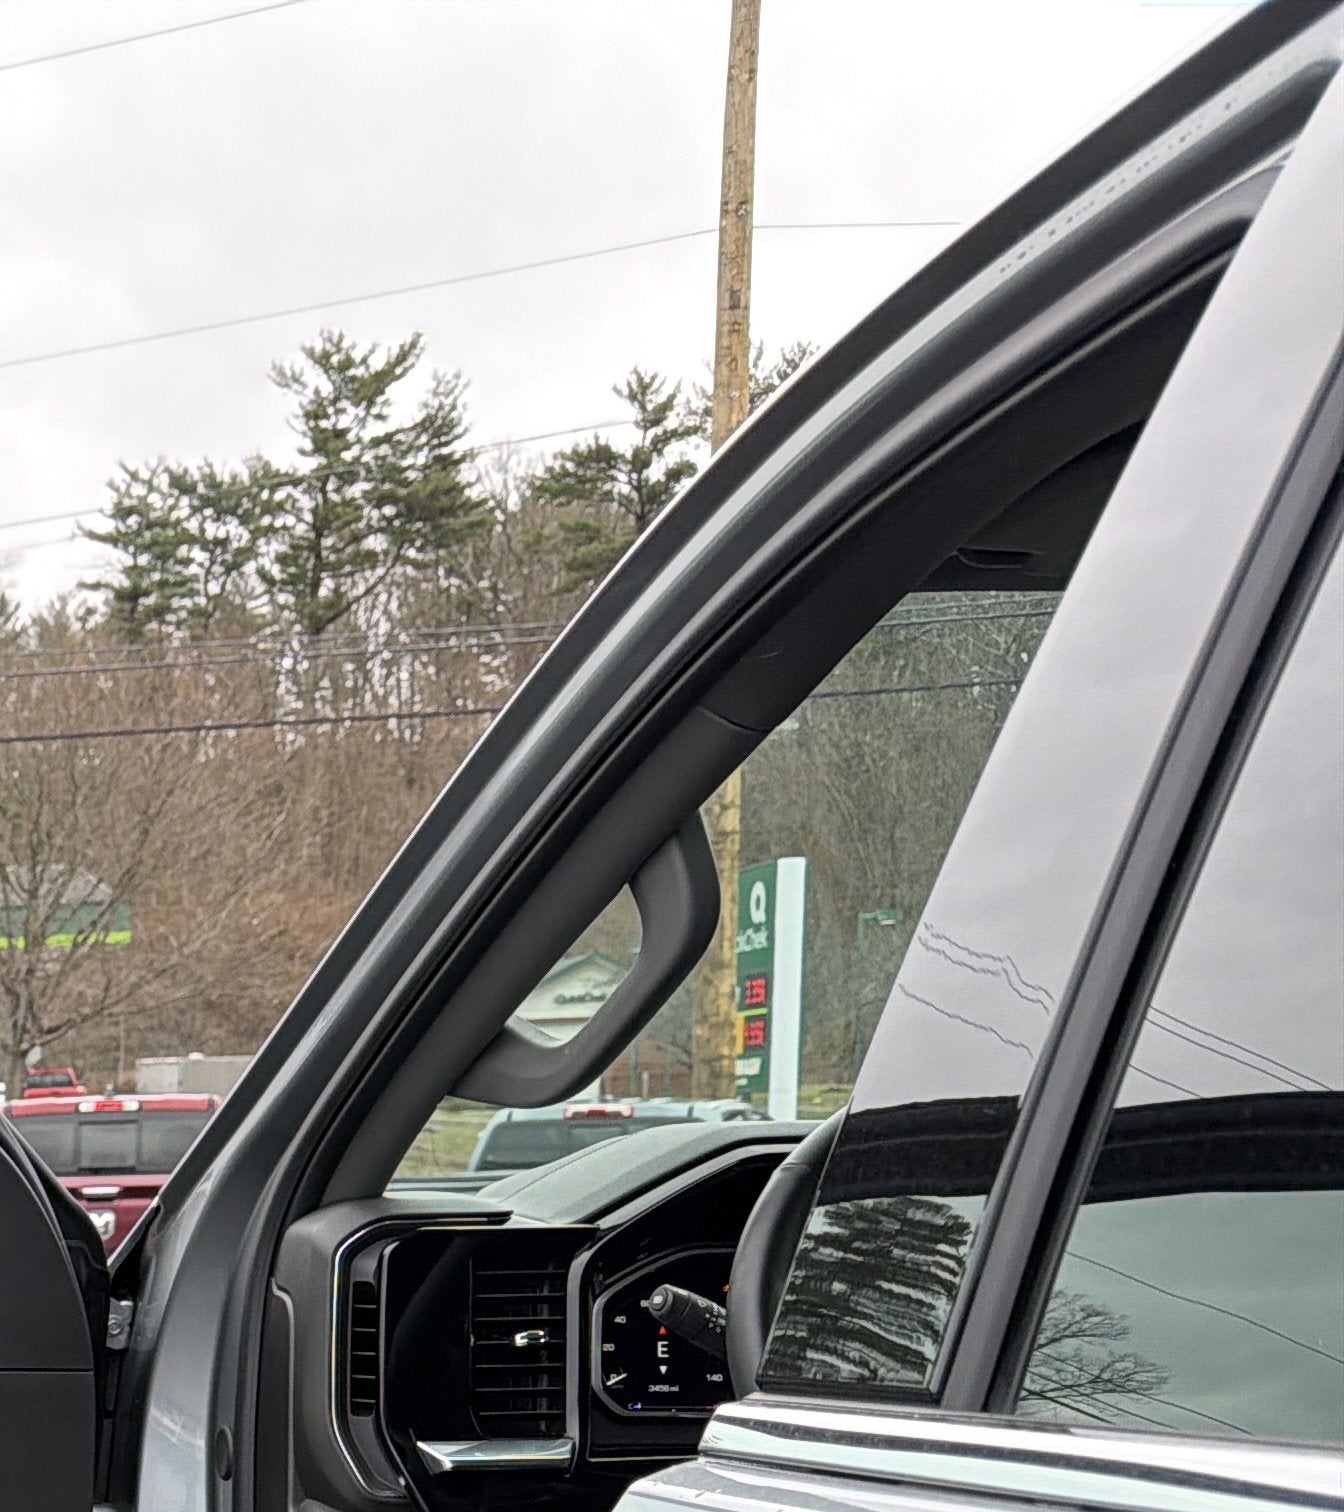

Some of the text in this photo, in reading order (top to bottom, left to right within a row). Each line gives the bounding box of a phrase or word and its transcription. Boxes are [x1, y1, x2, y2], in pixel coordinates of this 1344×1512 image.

[750, 880, 766, 924] Q
[614, 1315, 627, 1324] 40
[602, 1343, 615, 1352] 20
[657, 1341, 670, 1358] E
